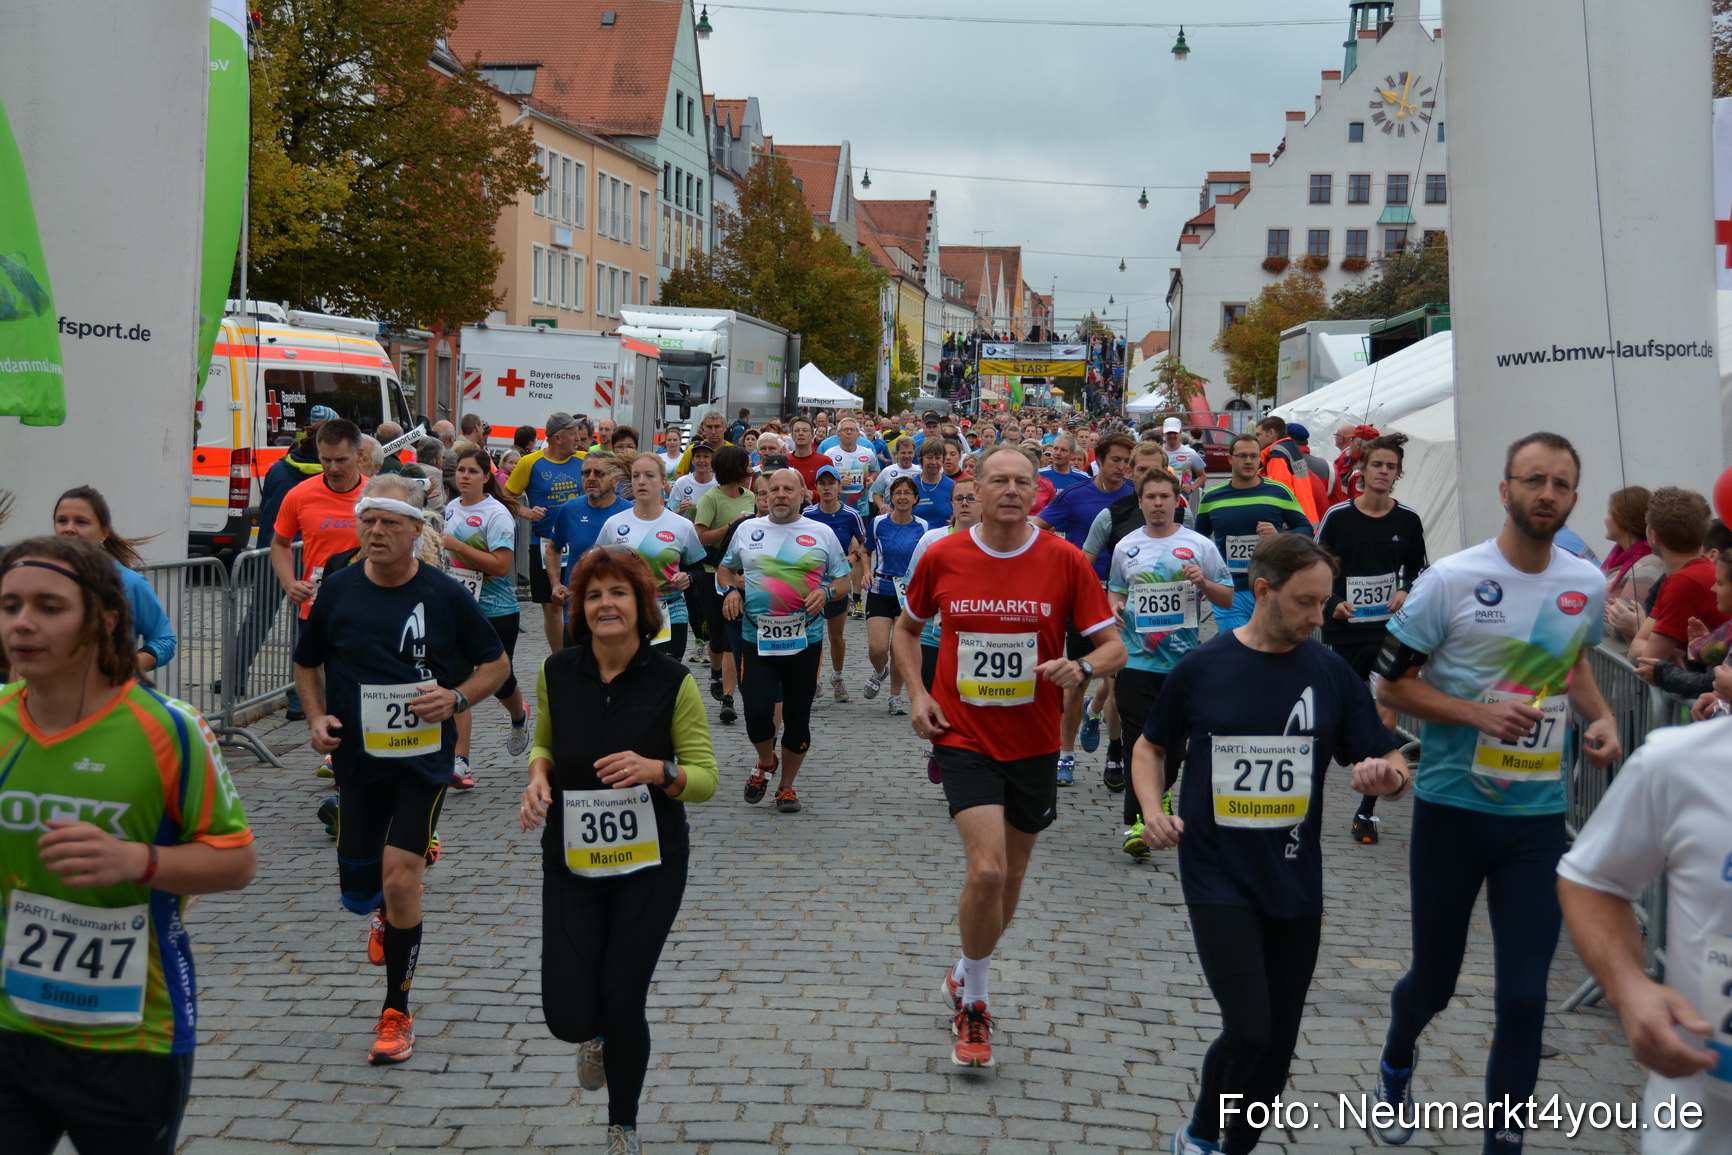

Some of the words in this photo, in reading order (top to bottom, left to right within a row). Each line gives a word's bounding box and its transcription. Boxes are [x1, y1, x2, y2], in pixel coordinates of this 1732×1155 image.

[1496, 339, 1713, 368] www.bmw-laufsport.de
[1013, 364, 1050, 373] START
[530, 370, 581, 381] Bayerisches
[529, 381, 554, 390] Rotes
[281, 391, 307, 404] Bayerisches
[528, 391, 553, 400] Kreuz
[801, 397, 835, 405] Laufsport
[283, 405, 296, 417] Rotes
[1353, 584, 1393, 605] 2537
[950, 599, 1038, 615] NEUMARKT
[1139, 593, 1181, 614] 2636
[1475, 610, 1505, 618] PARTL
[1148, 617, 1172, 626] Tobias
[762, 623, 802, 638] 2037
[771, 641, 796, 649] Norbert
[960, 638, 985, 648] PARTL
[986, 640, 1024, 648] Neumarkt
[974, 651, 1023, 679] 299
[363, 692, 389, 700] PARTL
[977, 685, 1016, 697] Werner
[388, 735, 419, 747] Janke
[1214, 744, 1247, 754] PARTL
[1249, 744, 1296, 754] Neumarkt
[1501, 754, 1545, 770] Manuel
[1233, 758, 1294, 792] 276
[565, 799, 592, 808] PARTL
[593, 796, 637, 807] Neumarkt
[1228, 801, 1295, 817] Stolpmann
[581, 809, 638, 844] 369
[590, 850, 633, 865] Marion
[14, 901, 58, 922] PARTL
[61, 911, 127, 931] Neumarkt
[18, 922, 137, 980] 2747
[41, 983, 100, 1008] Simon
